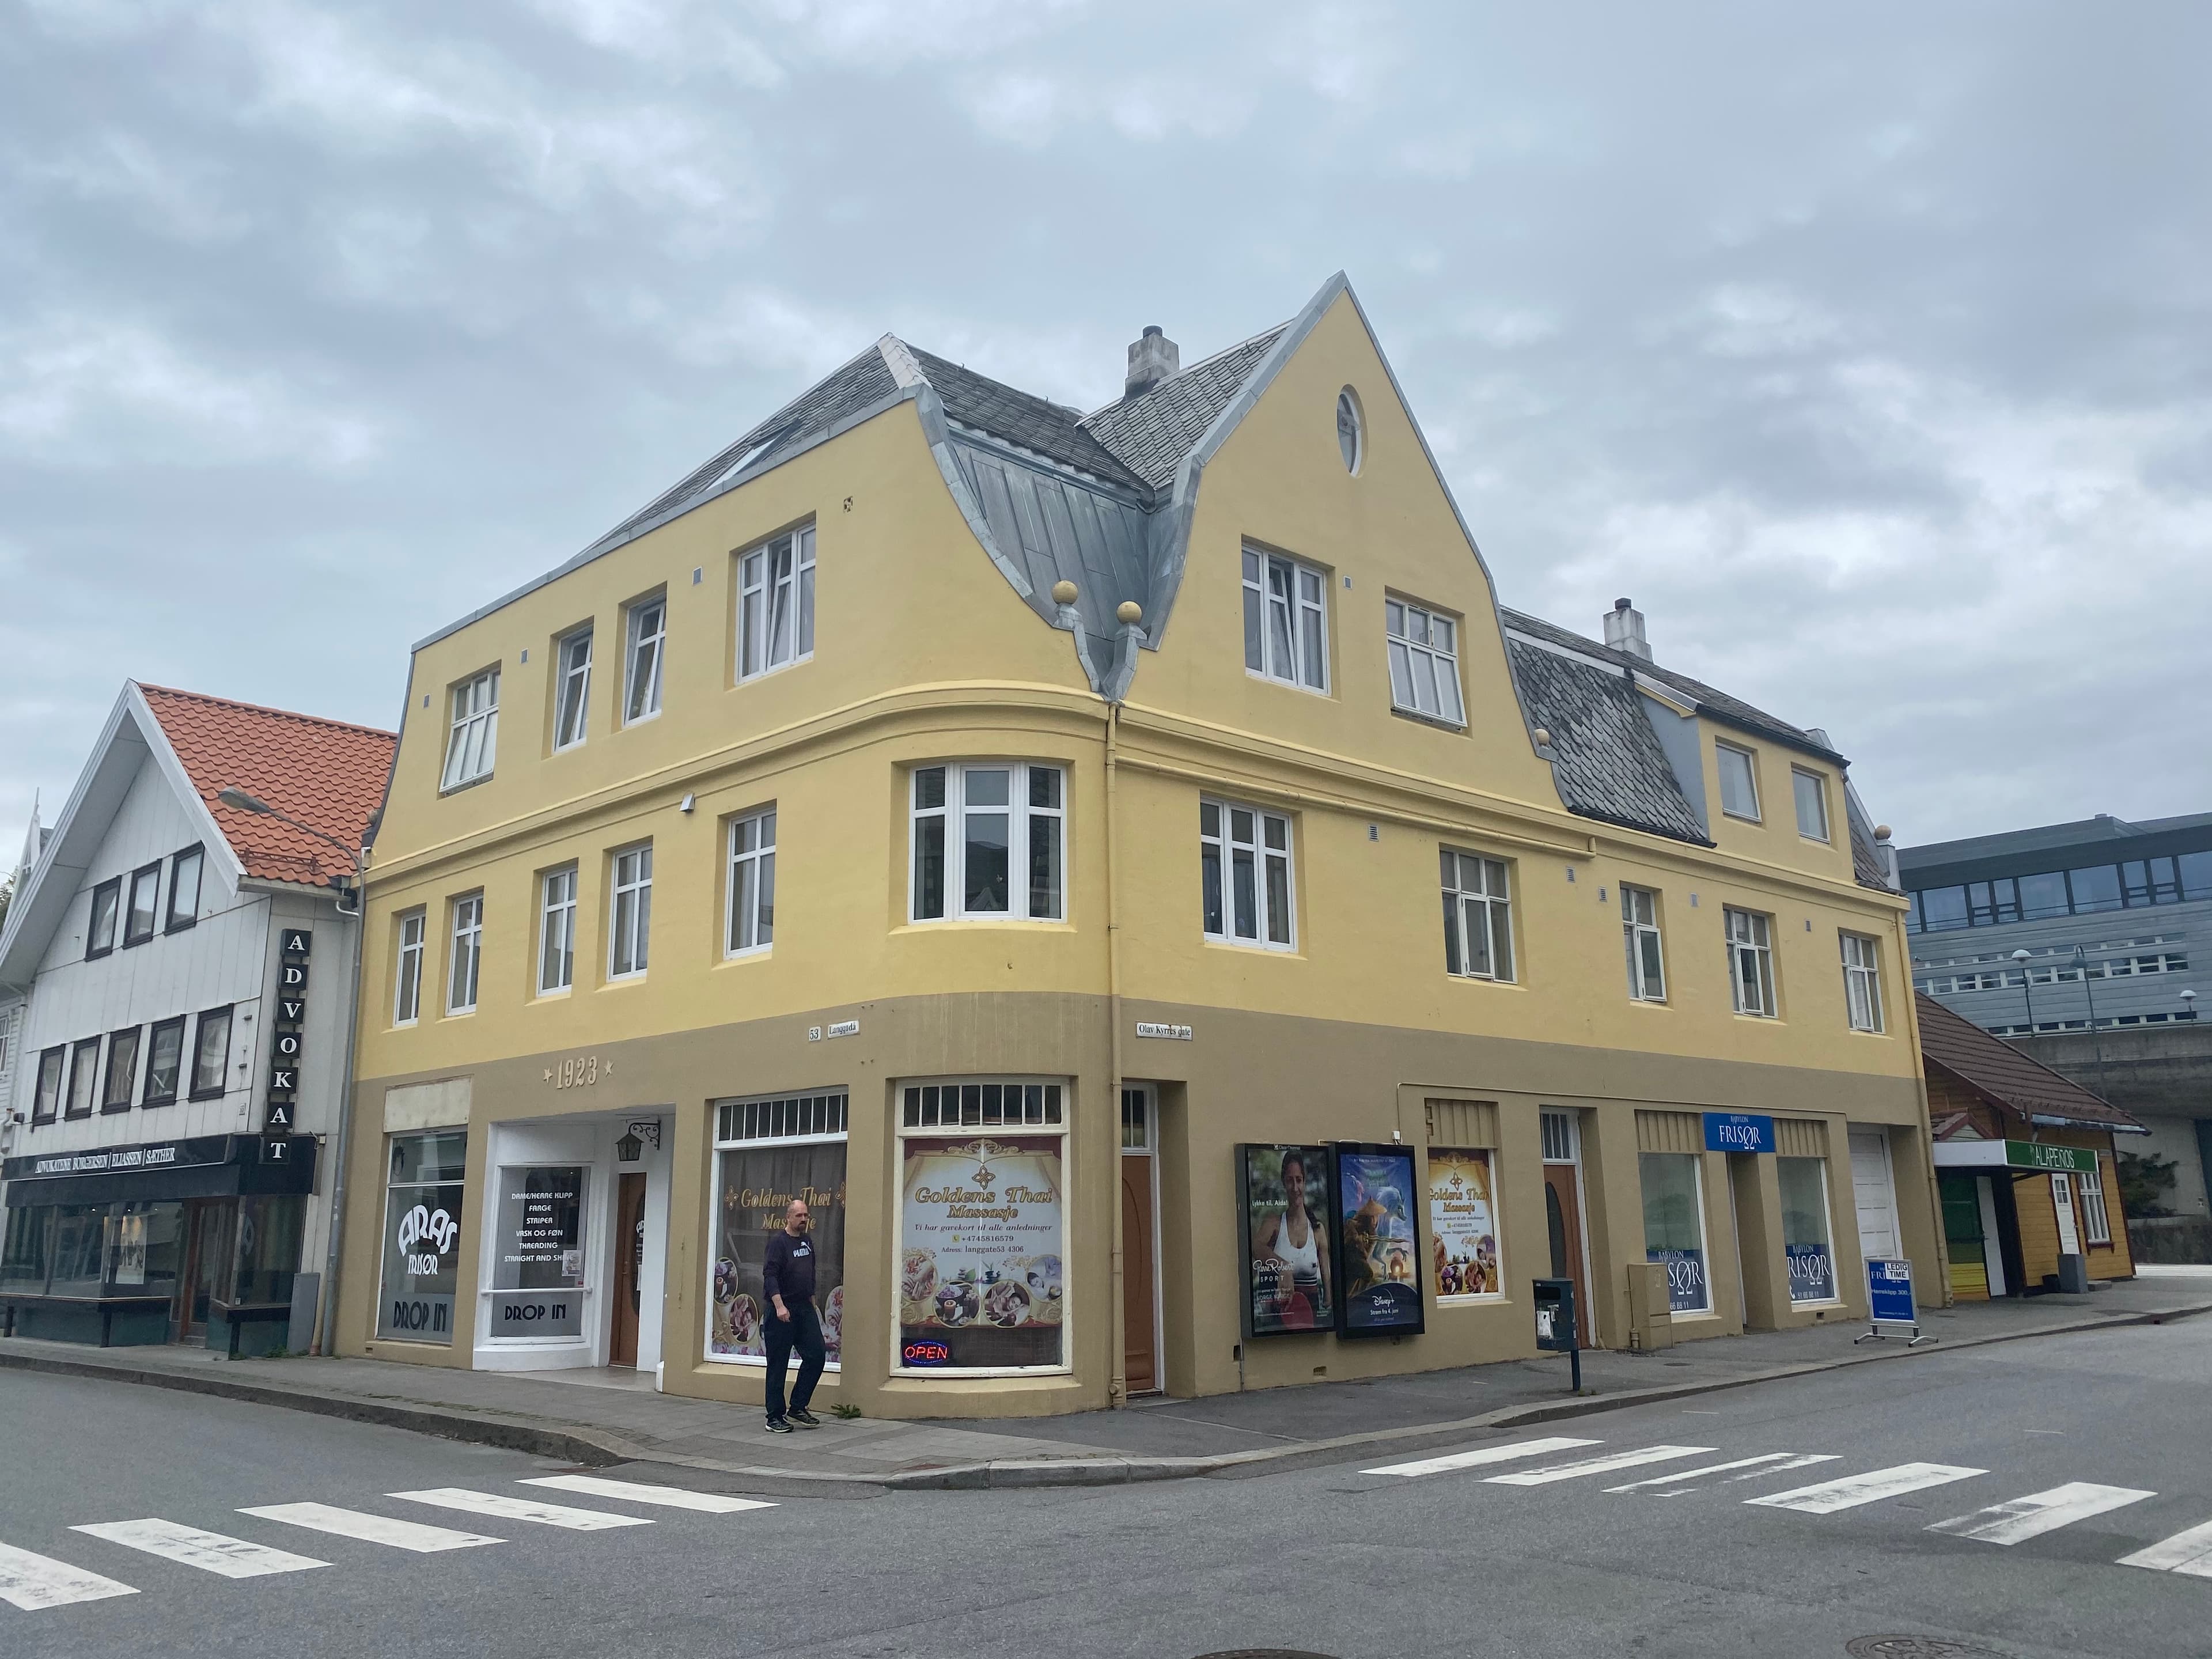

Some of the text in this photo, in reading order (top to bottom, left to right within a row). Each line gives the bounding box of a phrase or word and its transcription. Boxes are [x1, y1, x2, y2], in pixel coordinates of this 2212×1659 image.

[810, 1028, 819, 1040] 53
[1139, 1024, 1191, 1037] Olav Kyrres gate
[270, 935, 305, 1158] ADVOKAT
[556, 1056, 598, 1089] 1923
[1730, 1115, 1748, 1124] BABYLON
[1719, 1125, 1762, 1150] FRISØR
[741, 1186, 831, 1207] Goldens Thai
[915, 1185, 1052, 1203] Goldens Thai
[947, 1205, 1018, 1222] Massasje
[398, 1205, 457, 1257] ARAS
[760, 1213, 816, 1233] Masje
[940, 1224, 974, 1233] gavekort
[1006, 1224, 1052, 1233] anledninger
[1658, 1250, 1684, 1263] BABYLON
[1668, 1261, 1703, 1295] SØR
[1787, 1255, 1831, 1285] RISØR
[1871, 1271, 1885, 1279] FRI
[393, 1301, 448, 1332] DROP IN
[505, 1304, 566, 1320] DROP IN
[905, 1346, 948, 1359] OPEN
